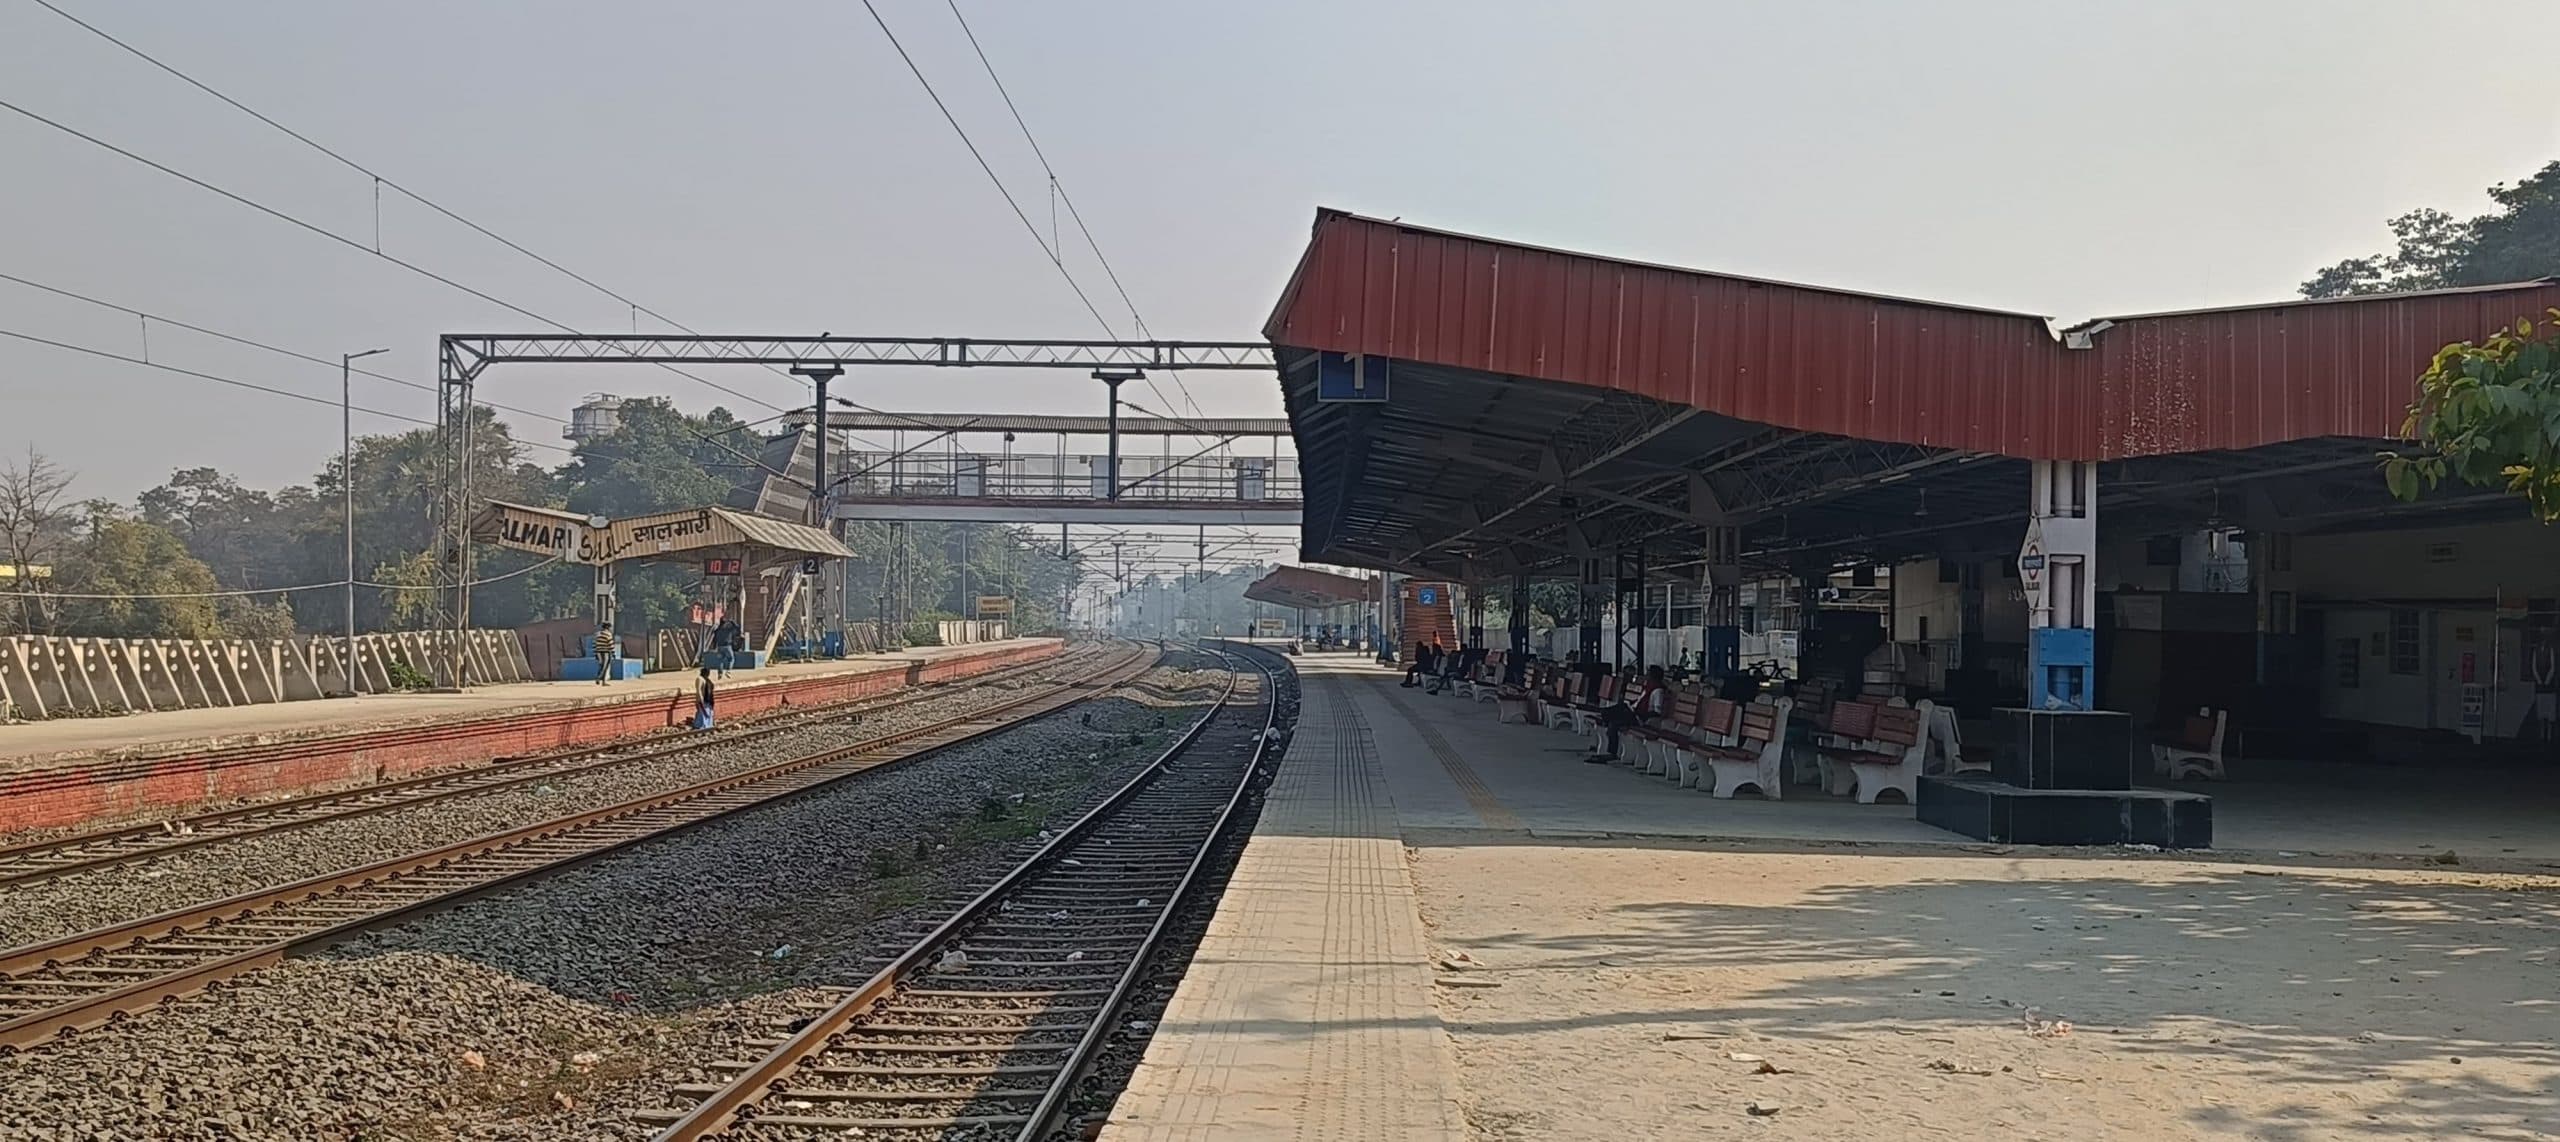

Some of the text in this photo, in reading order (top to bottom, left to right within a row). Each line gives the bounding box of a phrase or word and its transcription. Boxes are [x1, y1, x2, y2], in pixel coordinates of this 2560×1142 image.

[1344, 352, 1364, 389] 1
[499, 517, 572, 550] ALMARI
[631, 510, 712, 542] सालमारी
[710, 560, 740, 573] 10 12
[807, 559, 816, 572] 2
[1423, 594, 1432, 604] 2
